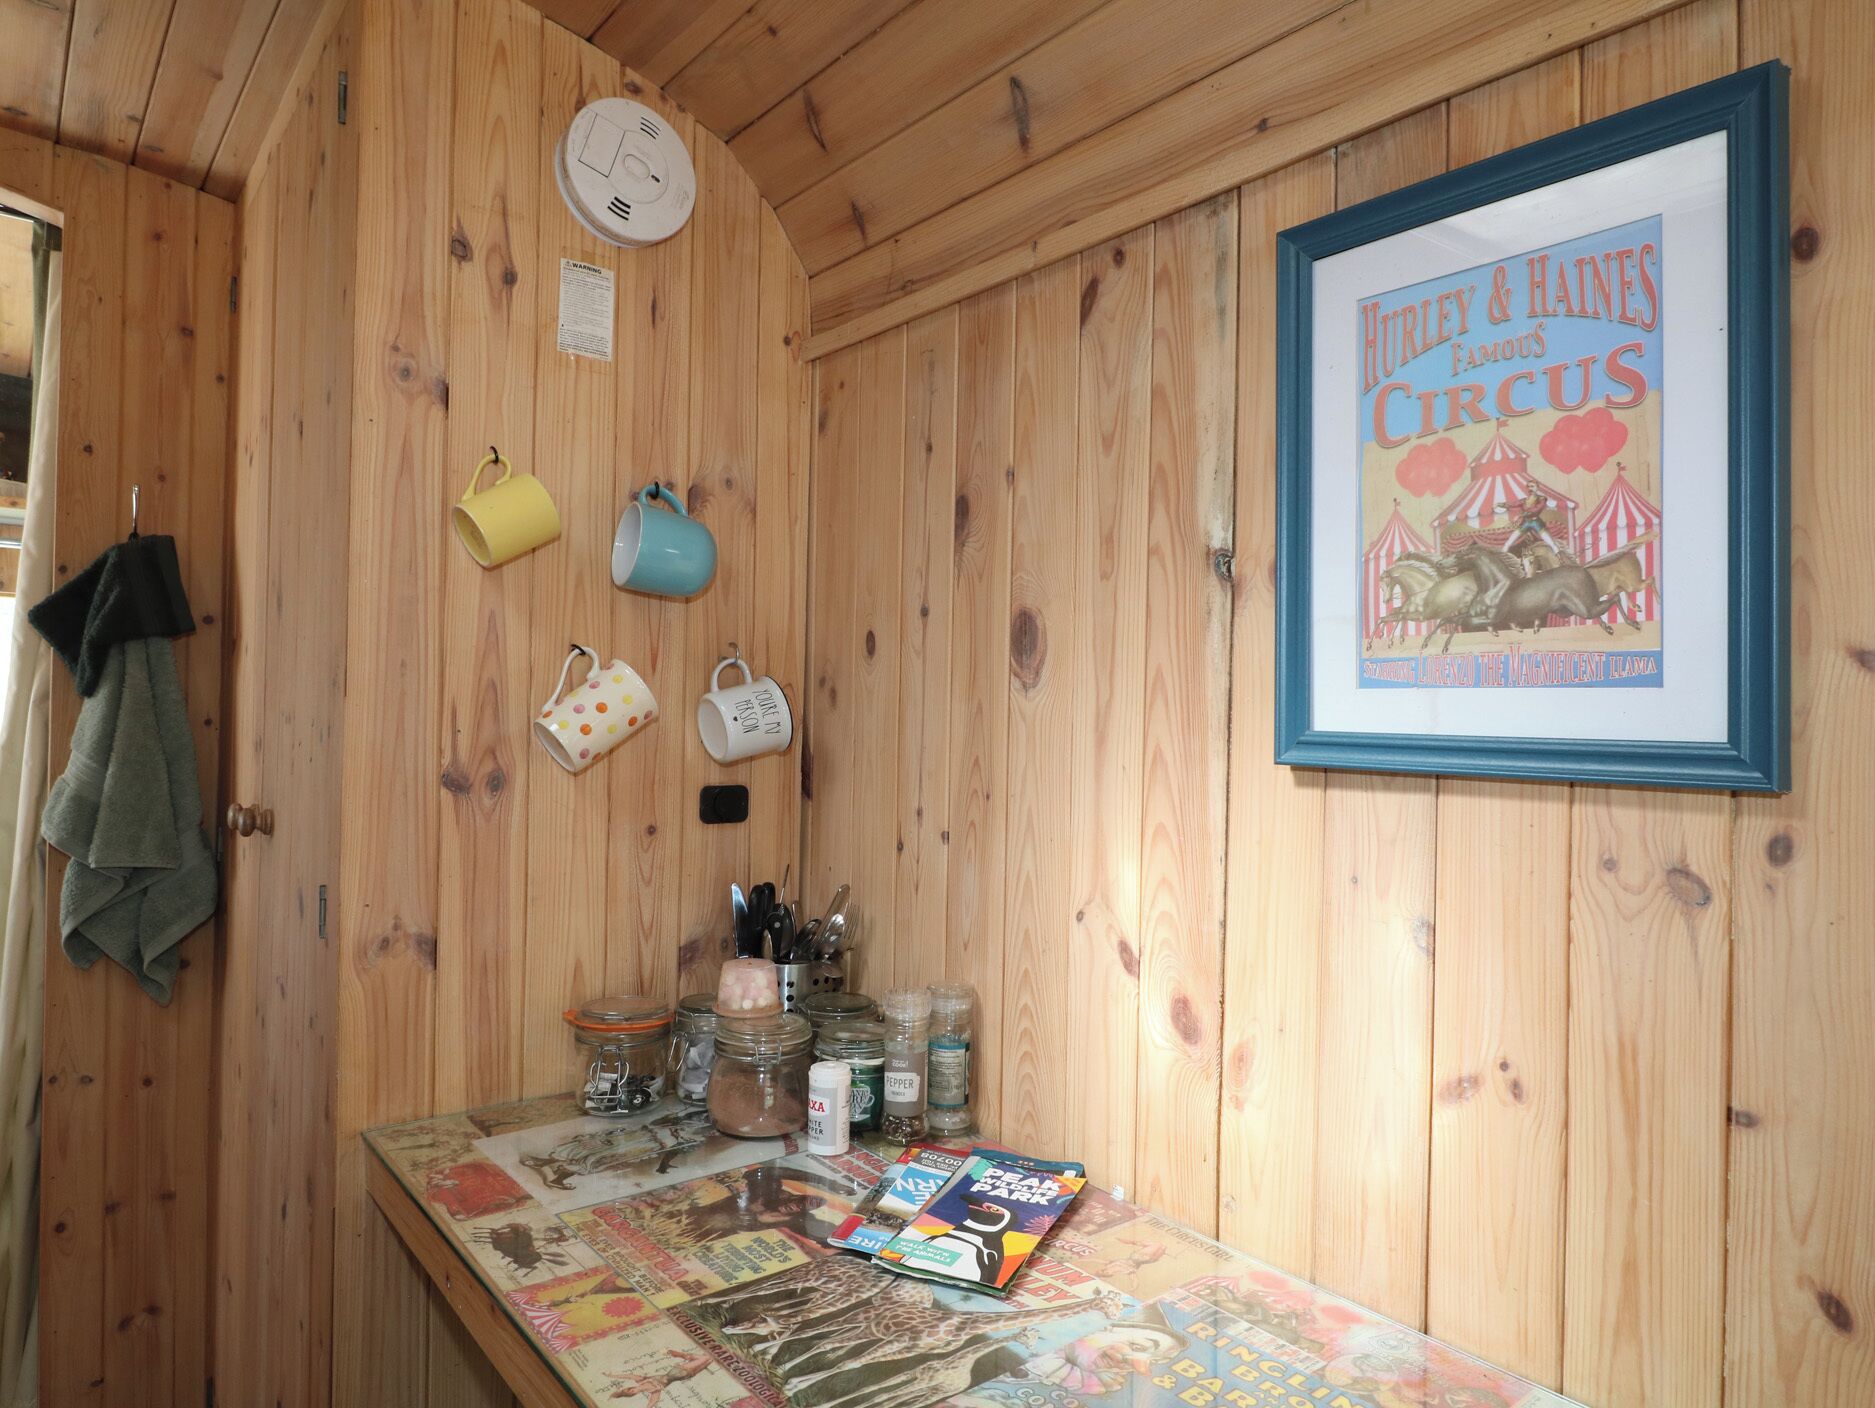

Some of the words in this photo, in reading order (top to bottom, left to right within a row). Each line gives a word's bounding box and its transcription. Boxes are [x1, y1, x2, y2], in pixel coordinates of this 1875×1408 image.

[571, 262, 602, 275] WARNING
[1361, 283, 1477, 395] HURLEY
[1487, 264, 1512, 324] &
[1527, 242, 1658, 331] HAINES
[1450, 320, 1547, 377] FAMOUS
[1372, 341, 1648, 449] CIRCUS
[1418, 649, 1475, 688] LORENZO
[1479, 651, 1505, 688] THE
[1507, 641, 1605, 688] MAGNIFICENT
[1609, 655, 1658, 679] LLAMA
[735, 699, 759, 734] PERSON
[886, 1075, 914, 1089] PEPPER
[979, 1177, 1059, 1197] WILDLIFE
[982, 1168, 1060, 1192] PEAK
[969, 1182, 1055, 1206] PARK
[900, 1241, 927, 1250] WALK
[927, 1246, 950, 1257] WITH
[1165, 1226, 1204, 1249] CIRCUS
[666, 1307, 717, 1346] EXCLUSIVE
[710, 1344, 741, 1369] RARE
[1151, 1373, 1177, 1389] &
